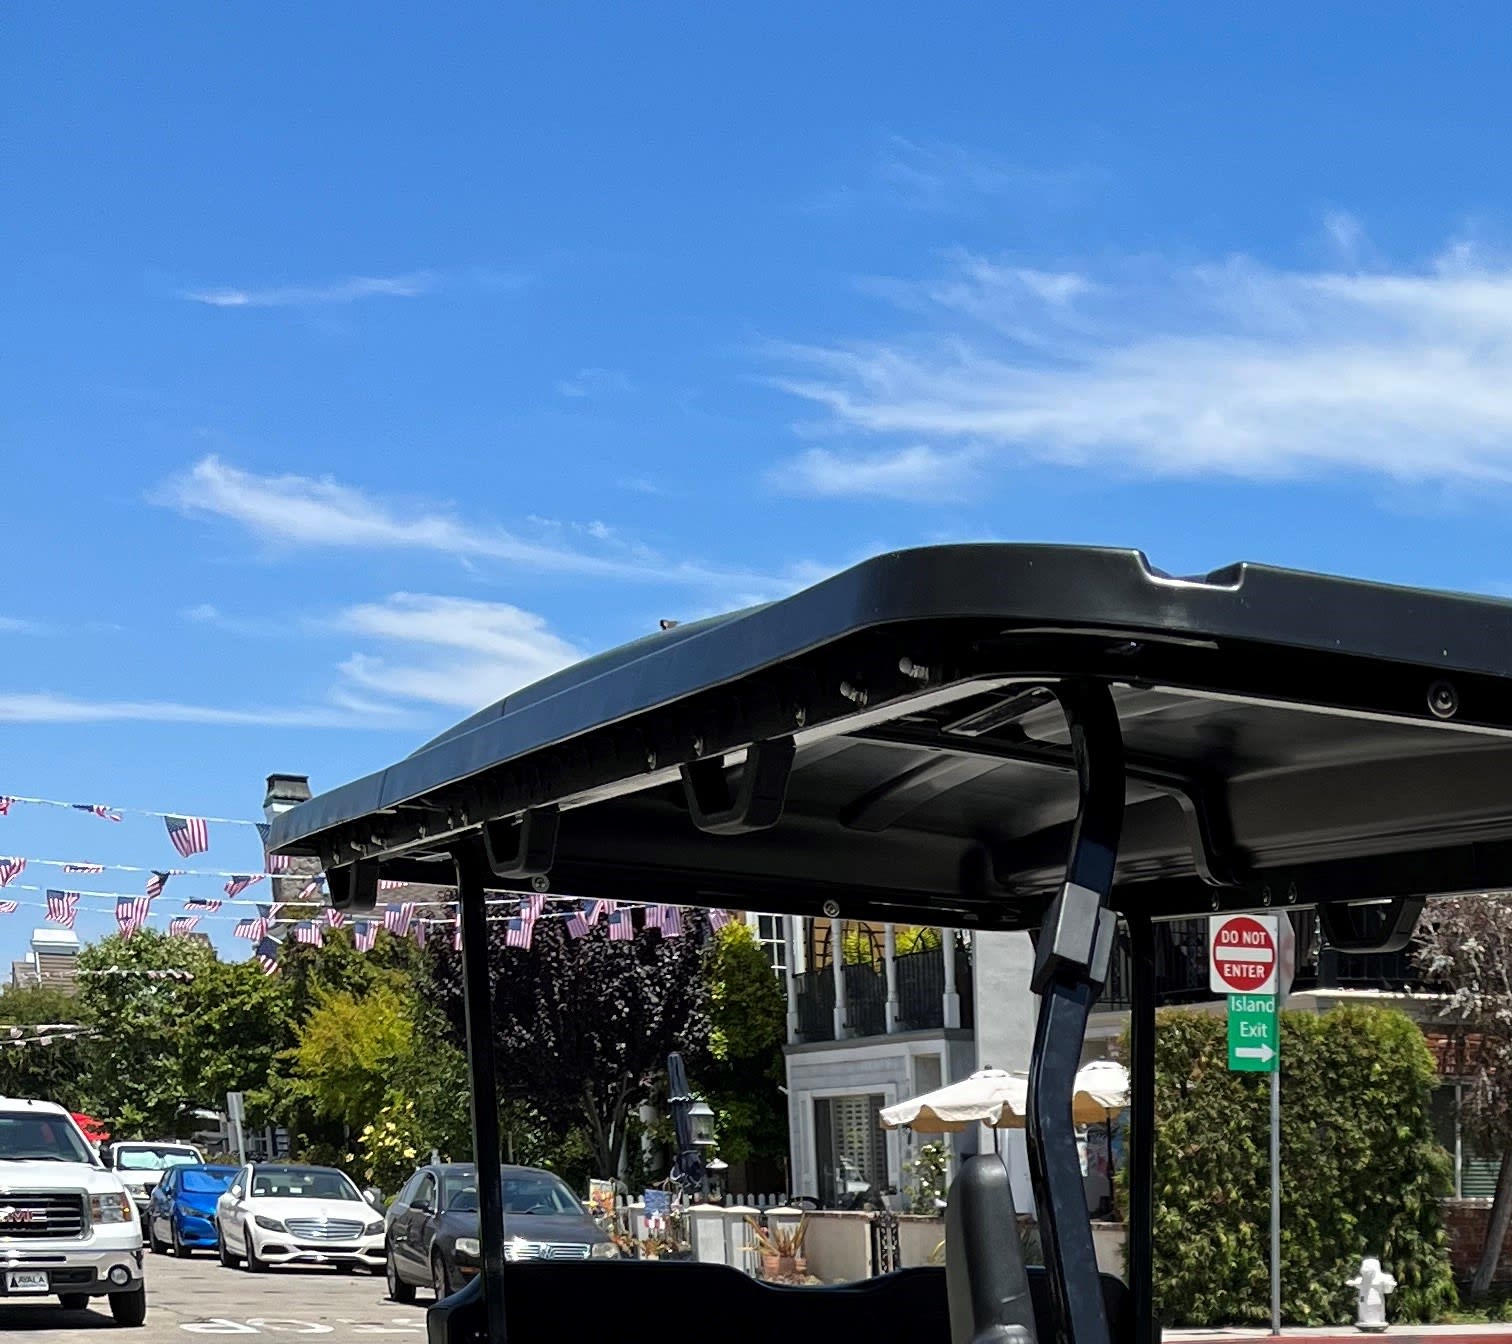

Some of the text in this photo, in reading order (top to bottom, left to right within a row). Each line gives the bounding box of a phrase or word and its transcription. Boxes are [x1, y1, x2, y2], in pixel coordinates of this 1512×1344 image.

[1221, 930, 1267, 944] DO NOT
[1223, 963, 1265, 978] ENTER
[1231, 996, 1275, 1013] Island
[1240, 1021, 1268, 1038] Exit
